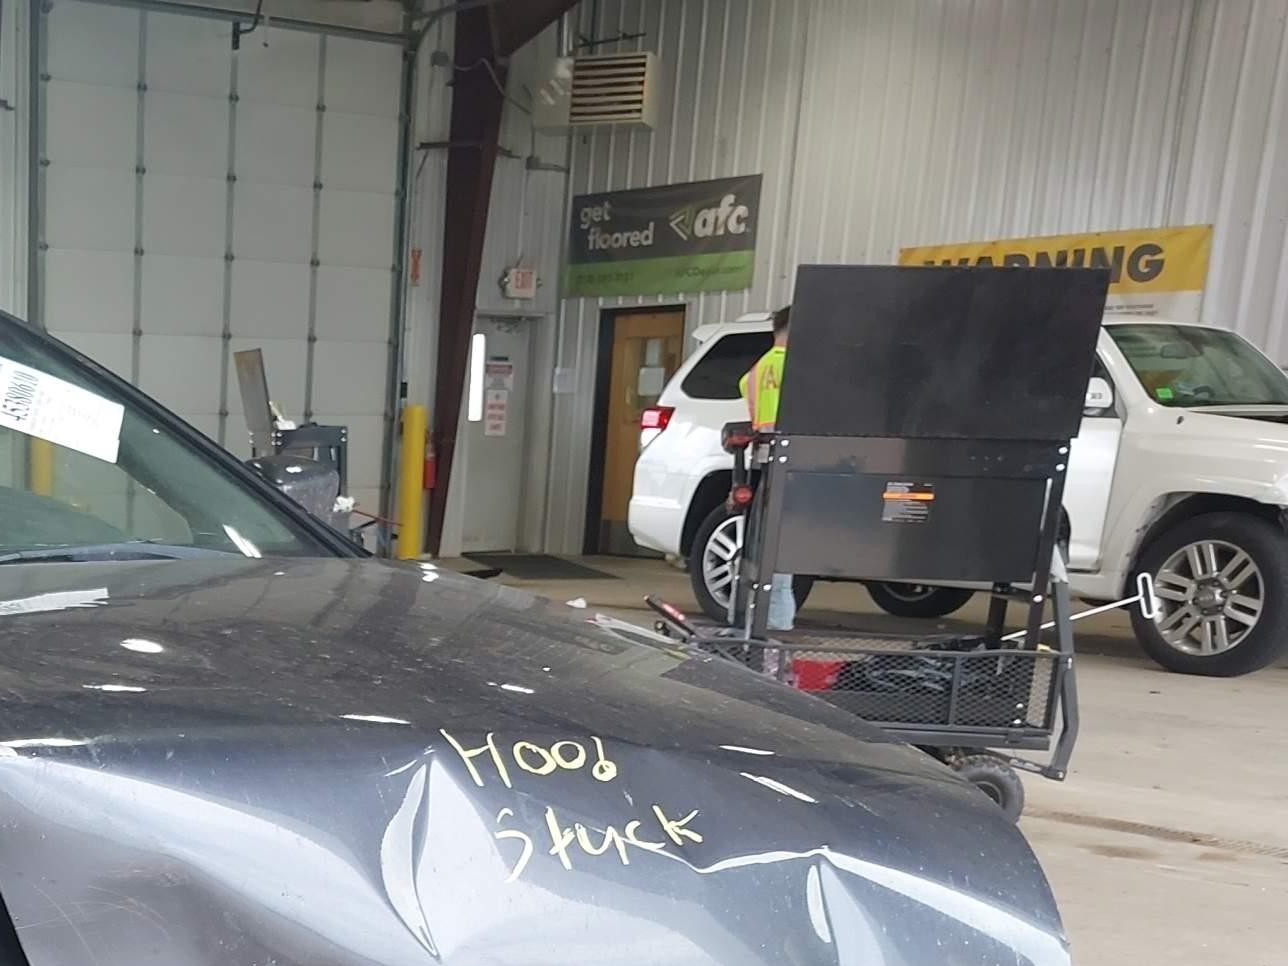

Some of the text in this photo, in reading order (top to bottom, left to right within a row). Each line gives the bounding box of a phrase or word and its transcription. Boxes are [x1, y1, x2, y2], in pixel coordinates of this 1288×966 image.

[580, 202, 611, 229] get
[693, 194, 749, 238] afc
[587, 221, 655, 250] floored
